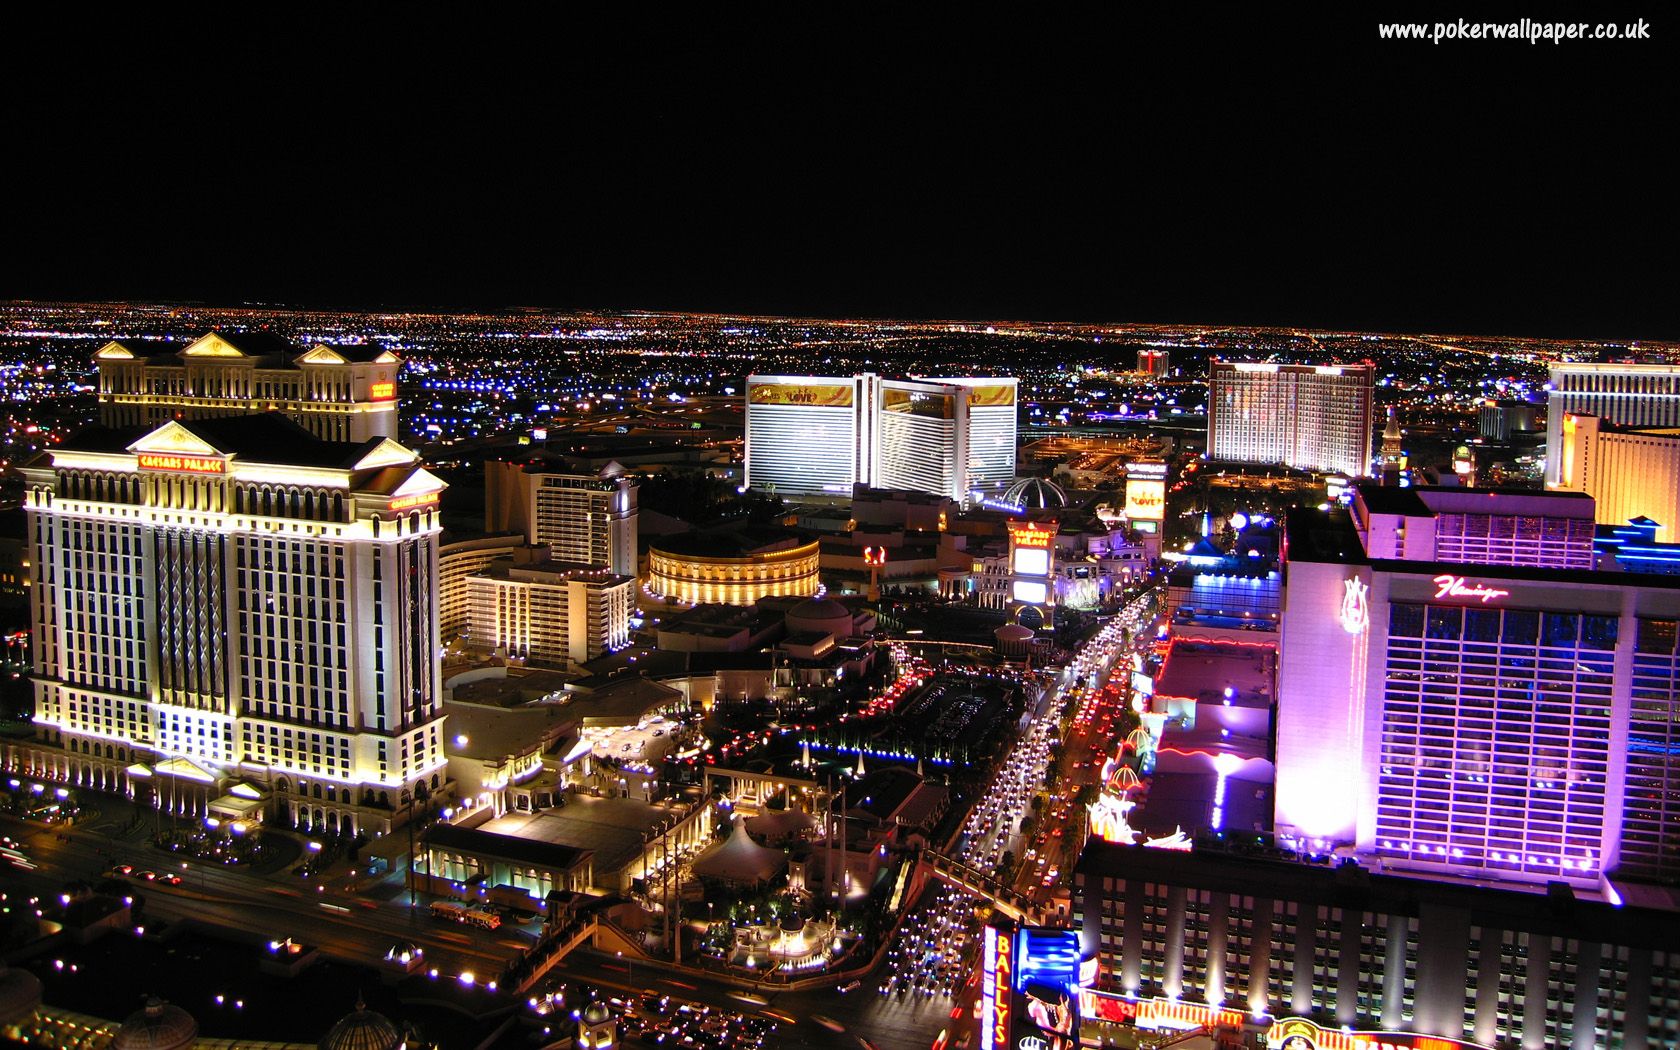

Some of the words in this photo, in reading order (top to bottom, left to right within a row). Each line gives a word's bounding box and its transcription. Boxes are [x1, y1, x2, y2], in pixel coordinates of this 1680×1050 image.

[141, 456, 182, 469] CAESARS
[184, 458, 222, 472] PALACE
[1135, 498, 1156, 506] LOVE
[1014, 530, 1050, 539] CAESARS
[1433, 575, 1509, 602] Flamingo
